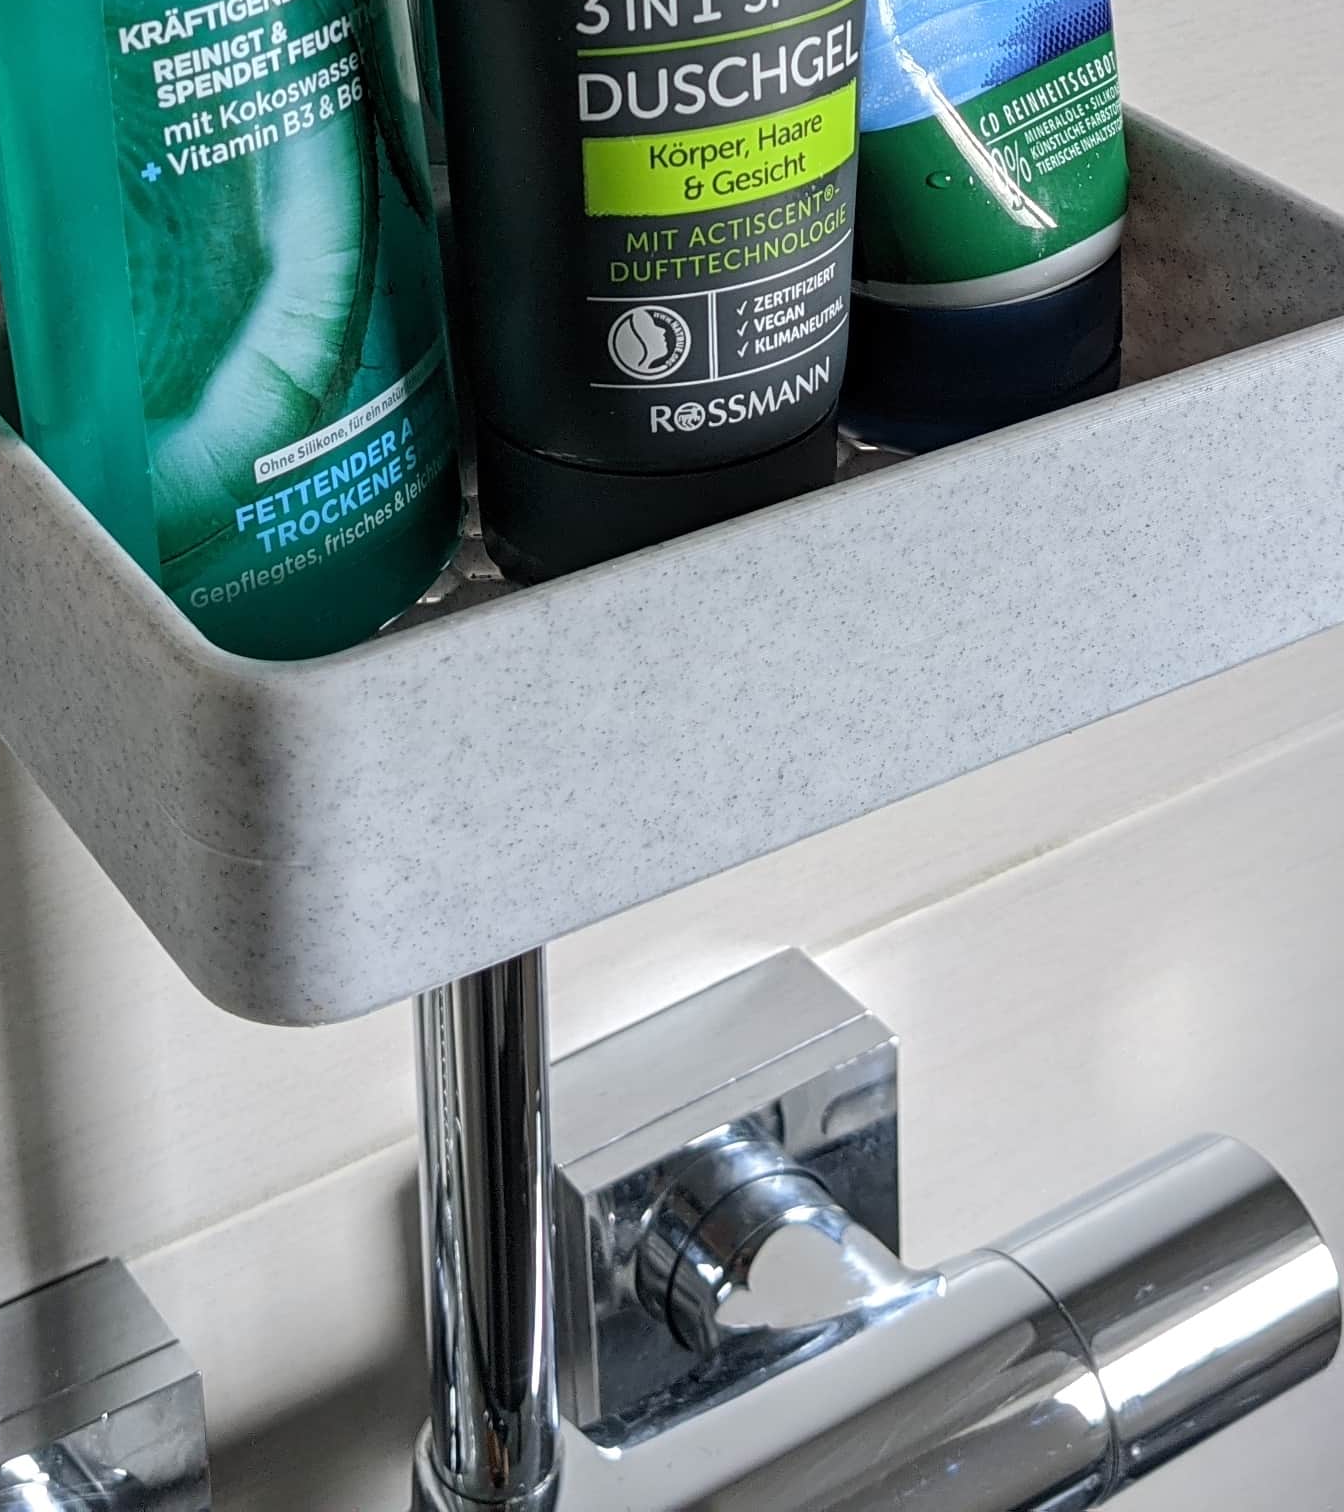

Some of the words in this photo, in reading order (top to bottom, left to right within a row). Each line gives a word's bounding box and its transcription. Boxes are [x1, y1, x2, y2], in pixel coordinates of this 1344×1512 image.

[152, 27, 264, 84] REINIGT
[270, 20, 288, 45] &
[157, 46, 283, 109] SPENDET
[578, 19, 859, 121] DUSCHGEL
[978, 115, 1000, 138] CD
[1003, 50, 1117, 126] REINHEITSGEBOT
[1024, 100, 1086, 145] MINERALÖLE
[163, 111, 214, 147] mit
[166, 123, 278, 176] Vitamin
[283, 103, 315, 137] B3
[319, 93, 335, 121] &
[336, 76, 364, 112] B6
[649, 137, 750, 170] Körper,
[758, 113, 822, 151] Haare
[1030, 119, 1086, 160] KÜNSTLICHE
[683, 175, 704, 201] &
[712, 153, 806, 195] Gesicht
[1035, 142, 1083, 176] TIERISCHE
[610, 203, 848, 282] DUFTTECHNOLOGIE
[627, 228, 678, 253] MIT
[754, 263, 837, 313] ZERTIFIZIERT
[754, 303, 805, 334] VEGAN
[754, 296, 844, 355] KLIMANEUTRAL
[650, 356, 830, 434] ROSSMANN
[259, 452, 295, 476] Ohne
[297, 427, 348, 461] Silikone,
[348, 414, 365, 433] für
[365, 403, 382, 423] ein
[235, 429, 397, 532] FETTENDER
[256, 458, 403, 553] TROCKENE
[190, 547, 323, 609] Gepflegtes,
[323, 502, 393, 558] frisches
[394, 491, 406, 512] &
